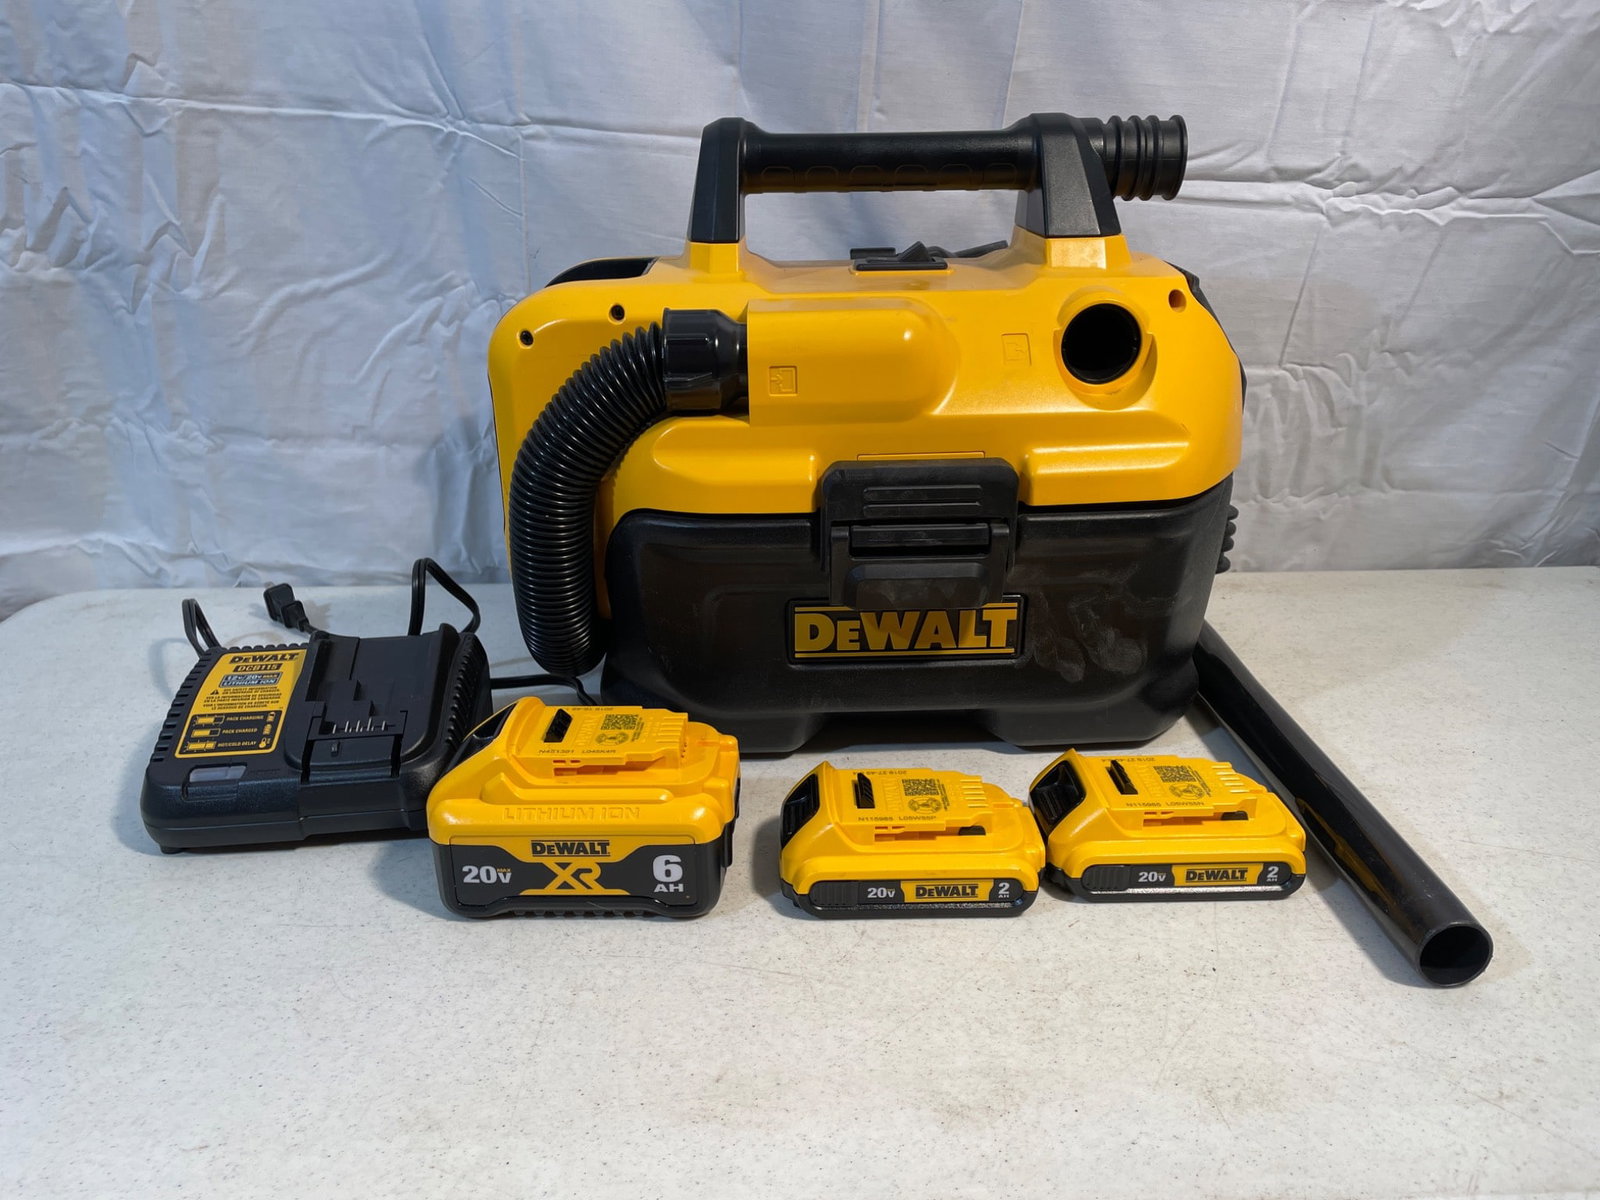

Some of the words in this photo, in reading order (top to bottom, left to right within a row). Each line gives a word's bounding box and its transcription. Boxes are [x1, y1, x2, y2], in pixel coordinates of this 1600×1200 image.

[795, 608, 1018, 651] DEWALT
[230, 653, 298, 663] DEWALT
[503, 807, 595, 821] LITHIUM
[601, 806, 641, 820] ION
[530, 841, 611, 856] DEWALT
[652, 854, 684, 883] 6
[1267, 866, 1280, 878] 2
[541, 862, 606, 890] XR
[1185, 869, 1248, 881] DEWALT
[653, 883, 684, 892] AH
[915, 886, 979, 897] DEWALT
[998, 882, 1010, 894] 2
